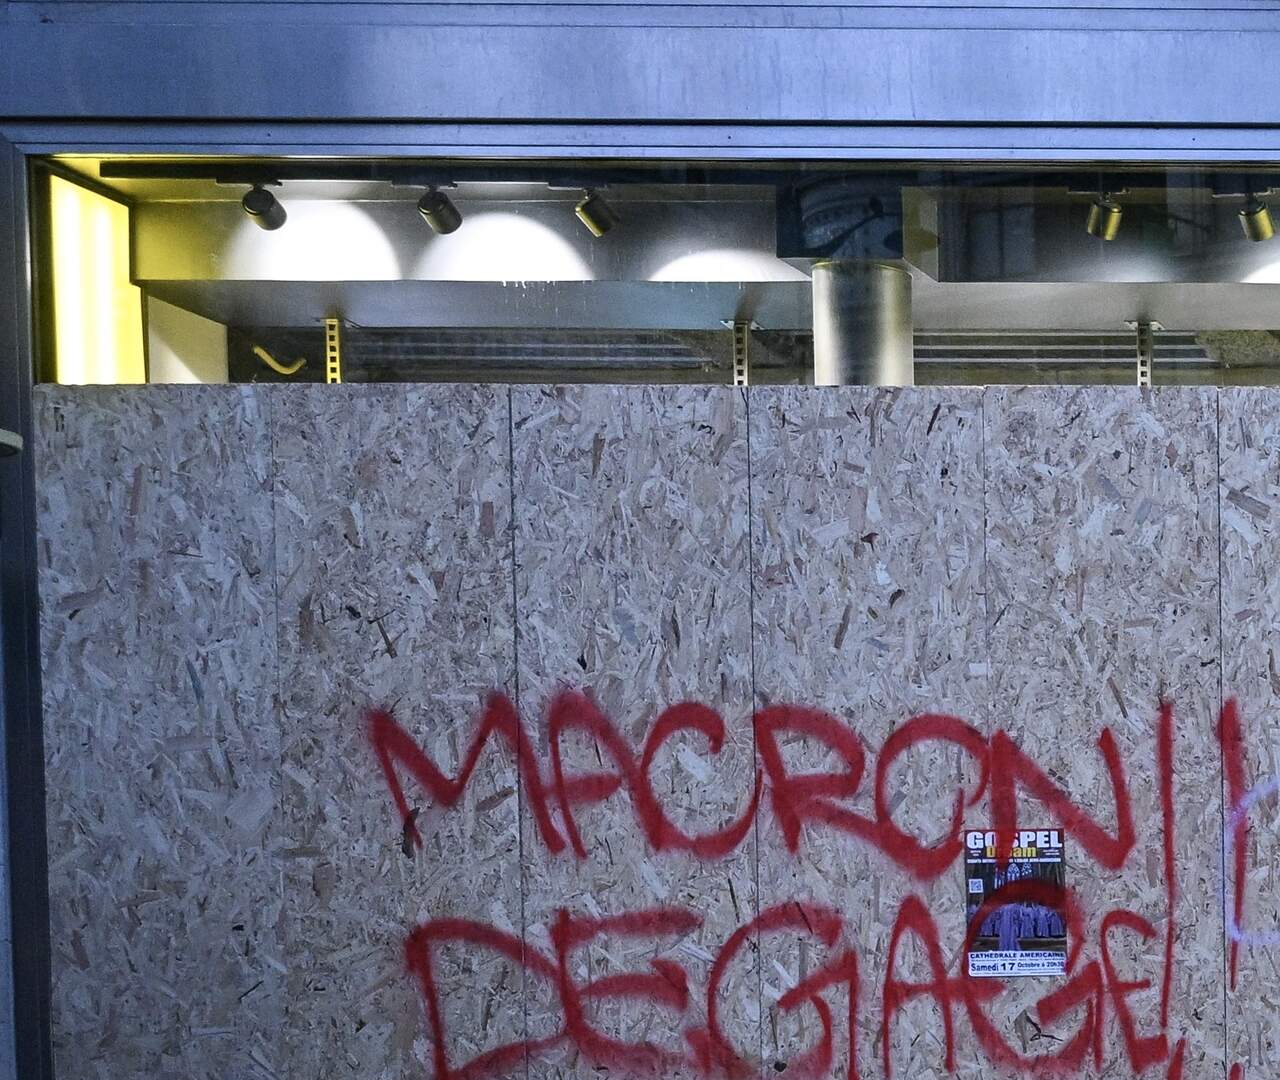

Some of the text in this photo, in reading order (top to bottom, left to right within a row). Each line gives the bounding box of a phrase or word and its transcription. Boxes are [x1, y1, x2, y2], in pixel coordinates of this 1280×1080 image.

[362, 686, 1137, 880] MACRON
[986, 847, 1037, 858] Dam
[971, 962, 1015, 972] Samedi 17
